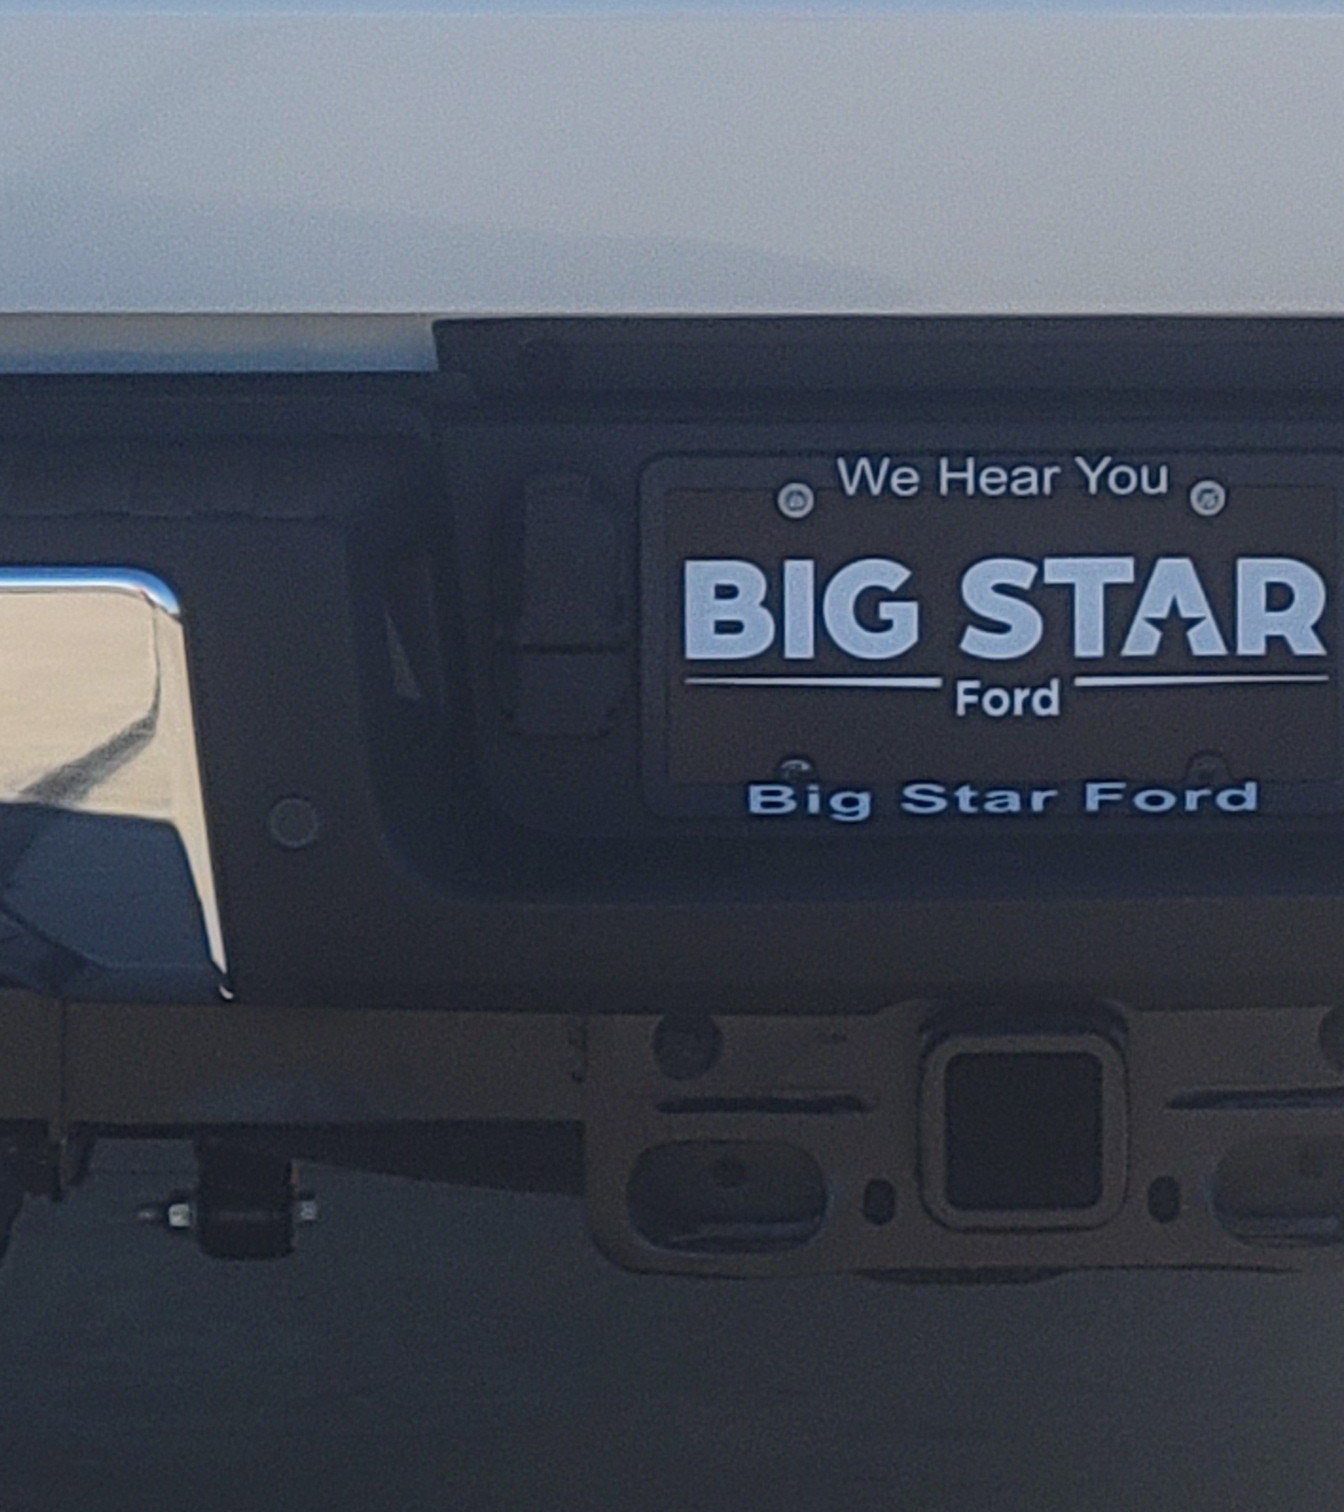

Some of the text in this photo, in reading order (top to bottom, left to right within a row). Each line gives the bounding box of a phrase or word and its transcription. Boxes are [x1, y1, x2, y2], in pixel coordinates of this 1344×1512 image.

[836, 456, 1170, 497] We Hear You
[684, 555, 1327, 660] BIG STAR
[955, 679, 1061, 717] Ford
[747, 782, 1258, 821] Big Star Ford
